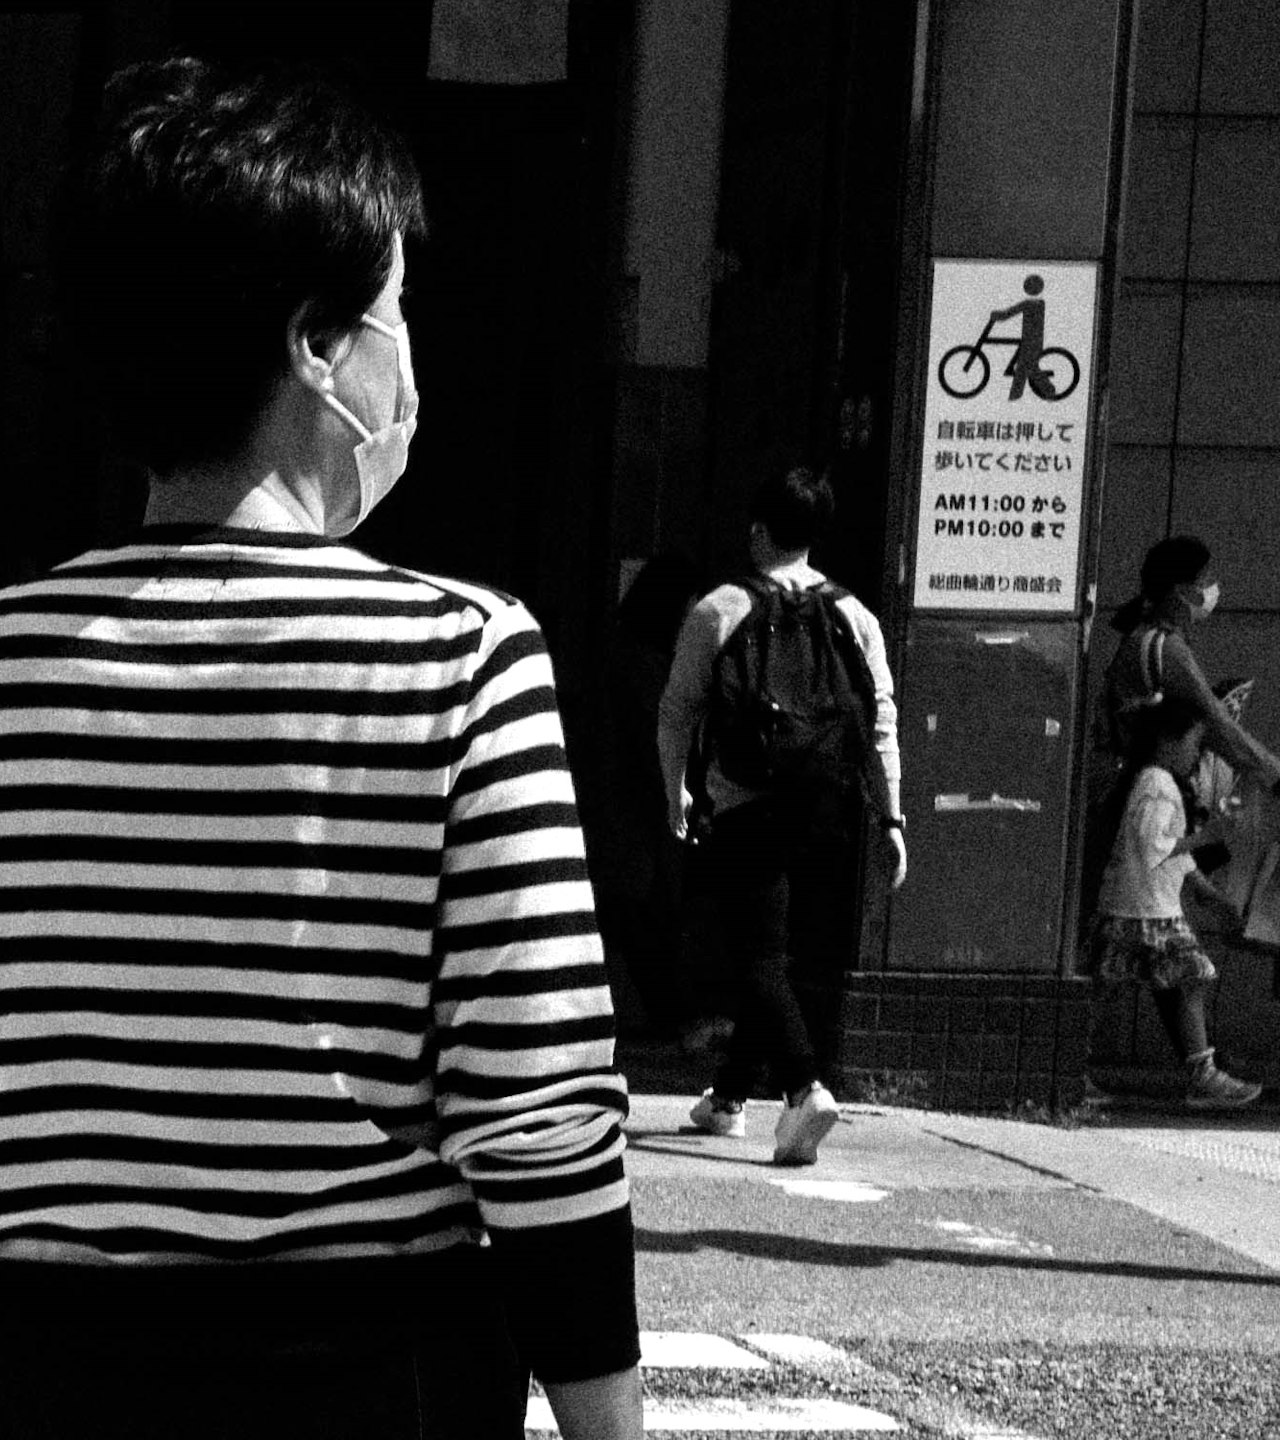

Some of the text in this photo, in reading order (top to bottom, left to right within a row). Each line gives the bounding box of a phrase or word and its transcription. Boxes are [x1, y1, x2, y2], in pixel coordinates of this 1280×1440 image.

[936, 420, 1074, 443] 自転車は押して
[934, 451, 1072, 472] 歩いてください
[934, 493, 1067, 513] AM11:00 から
[934, 519, 1066, 539] PM10:00 まで
